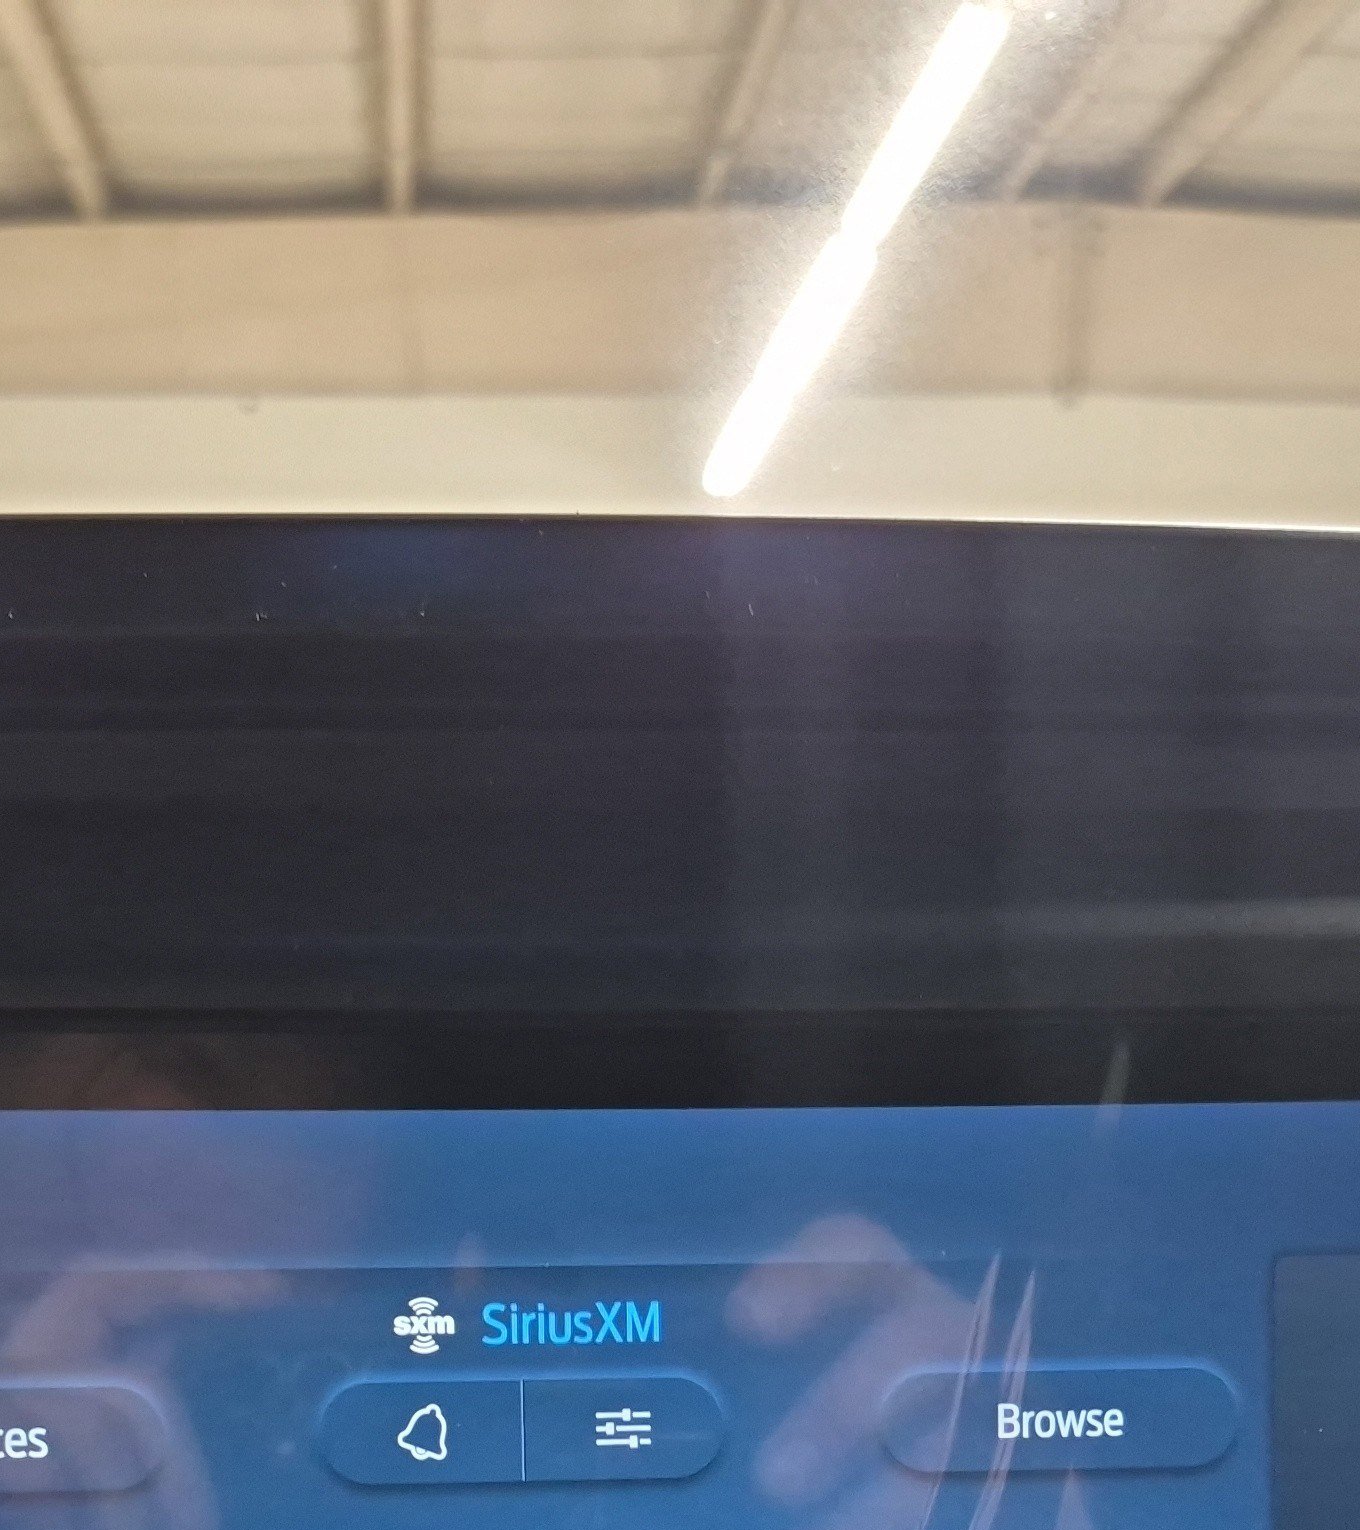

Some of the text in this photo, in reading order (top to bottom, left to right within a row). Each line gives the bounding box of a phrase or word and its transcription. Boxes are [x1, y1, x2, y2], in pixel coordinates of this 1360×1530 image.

[393, 1300, 662, 1346] sxm SiriusXM
[996, 1402, 1124, 1439] Browse
